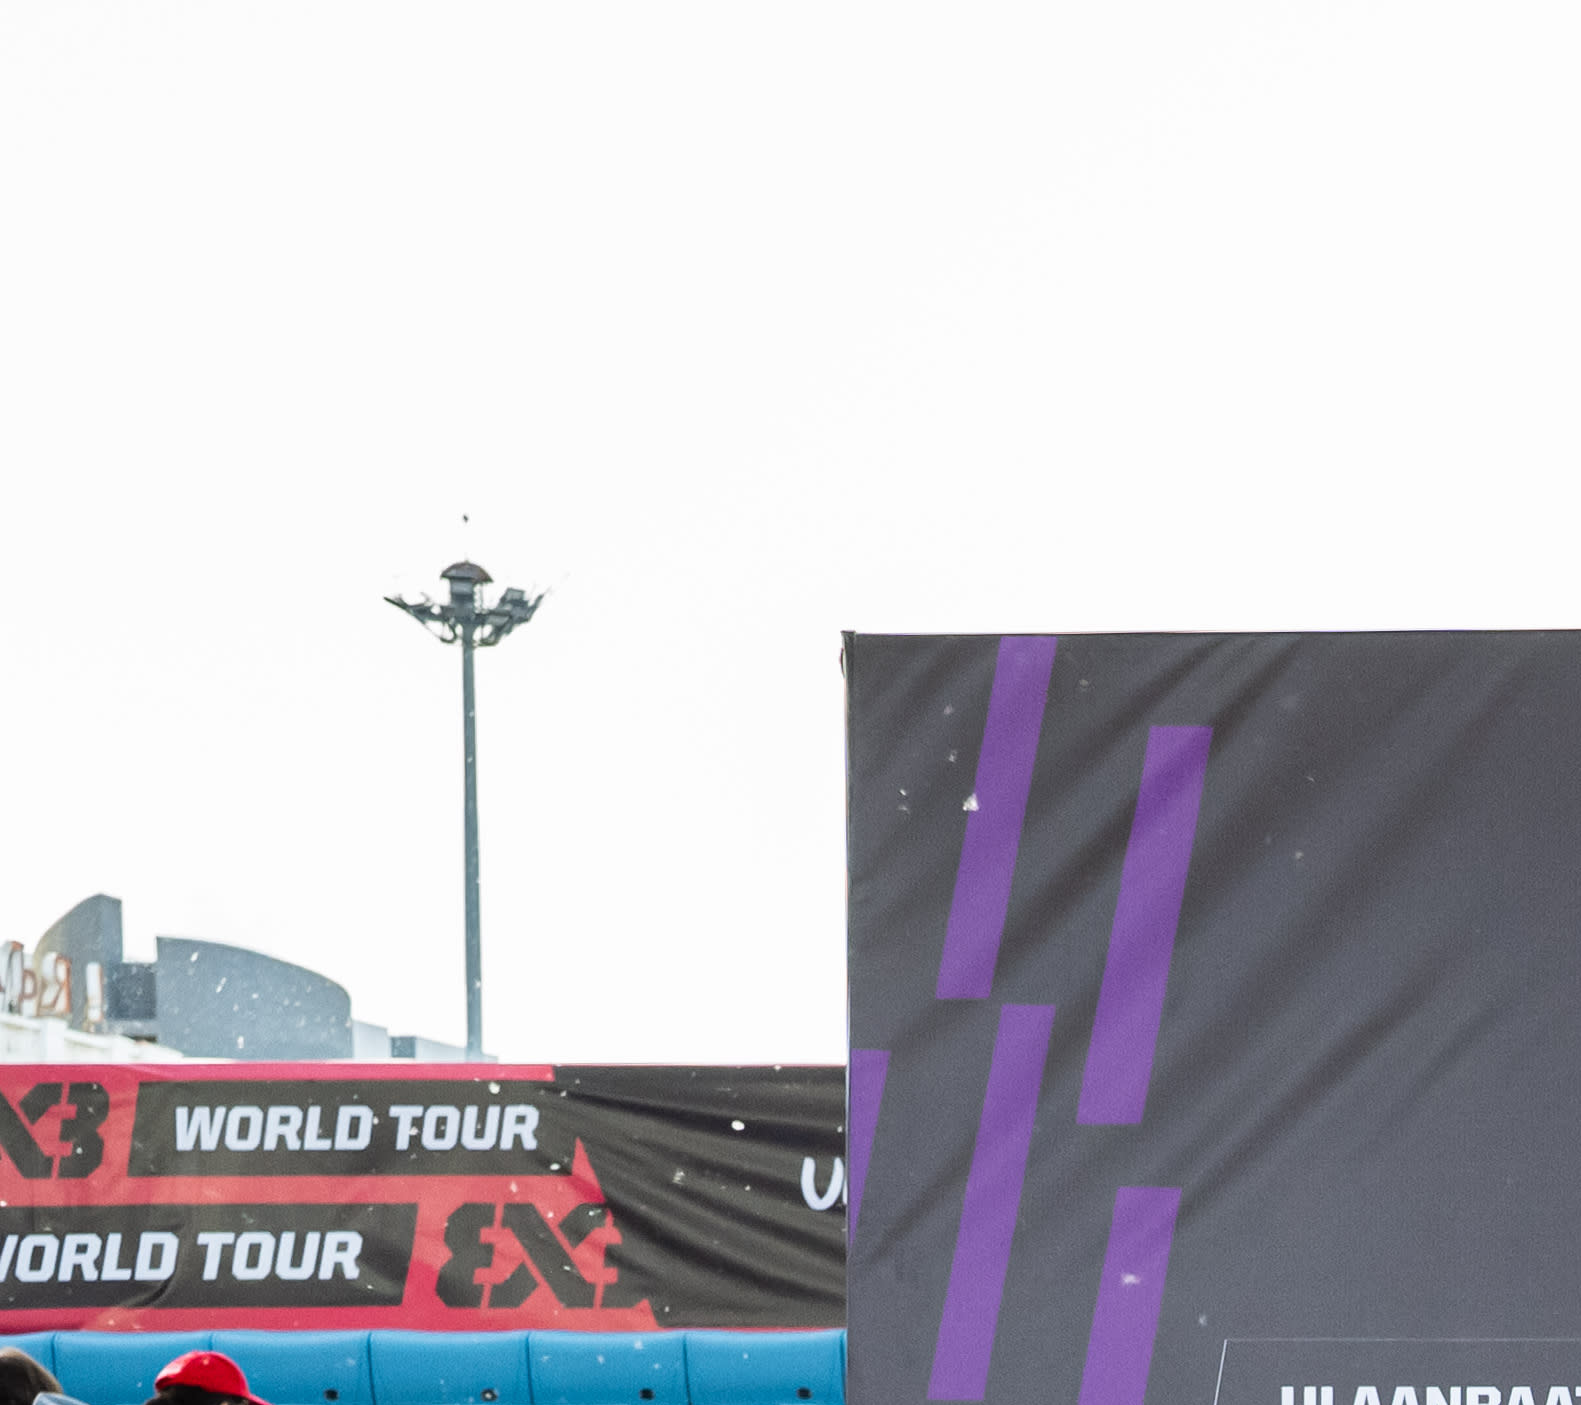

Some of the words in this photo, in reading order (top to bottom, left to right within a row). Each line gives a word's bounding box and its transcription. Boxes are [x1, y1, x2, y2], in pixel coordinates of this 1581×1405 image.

[174, 1105, 374, 1152] WORLD
[389, 1104, 540, 1151] TOUR
[198, 1231, 363, 1281] TOUR
